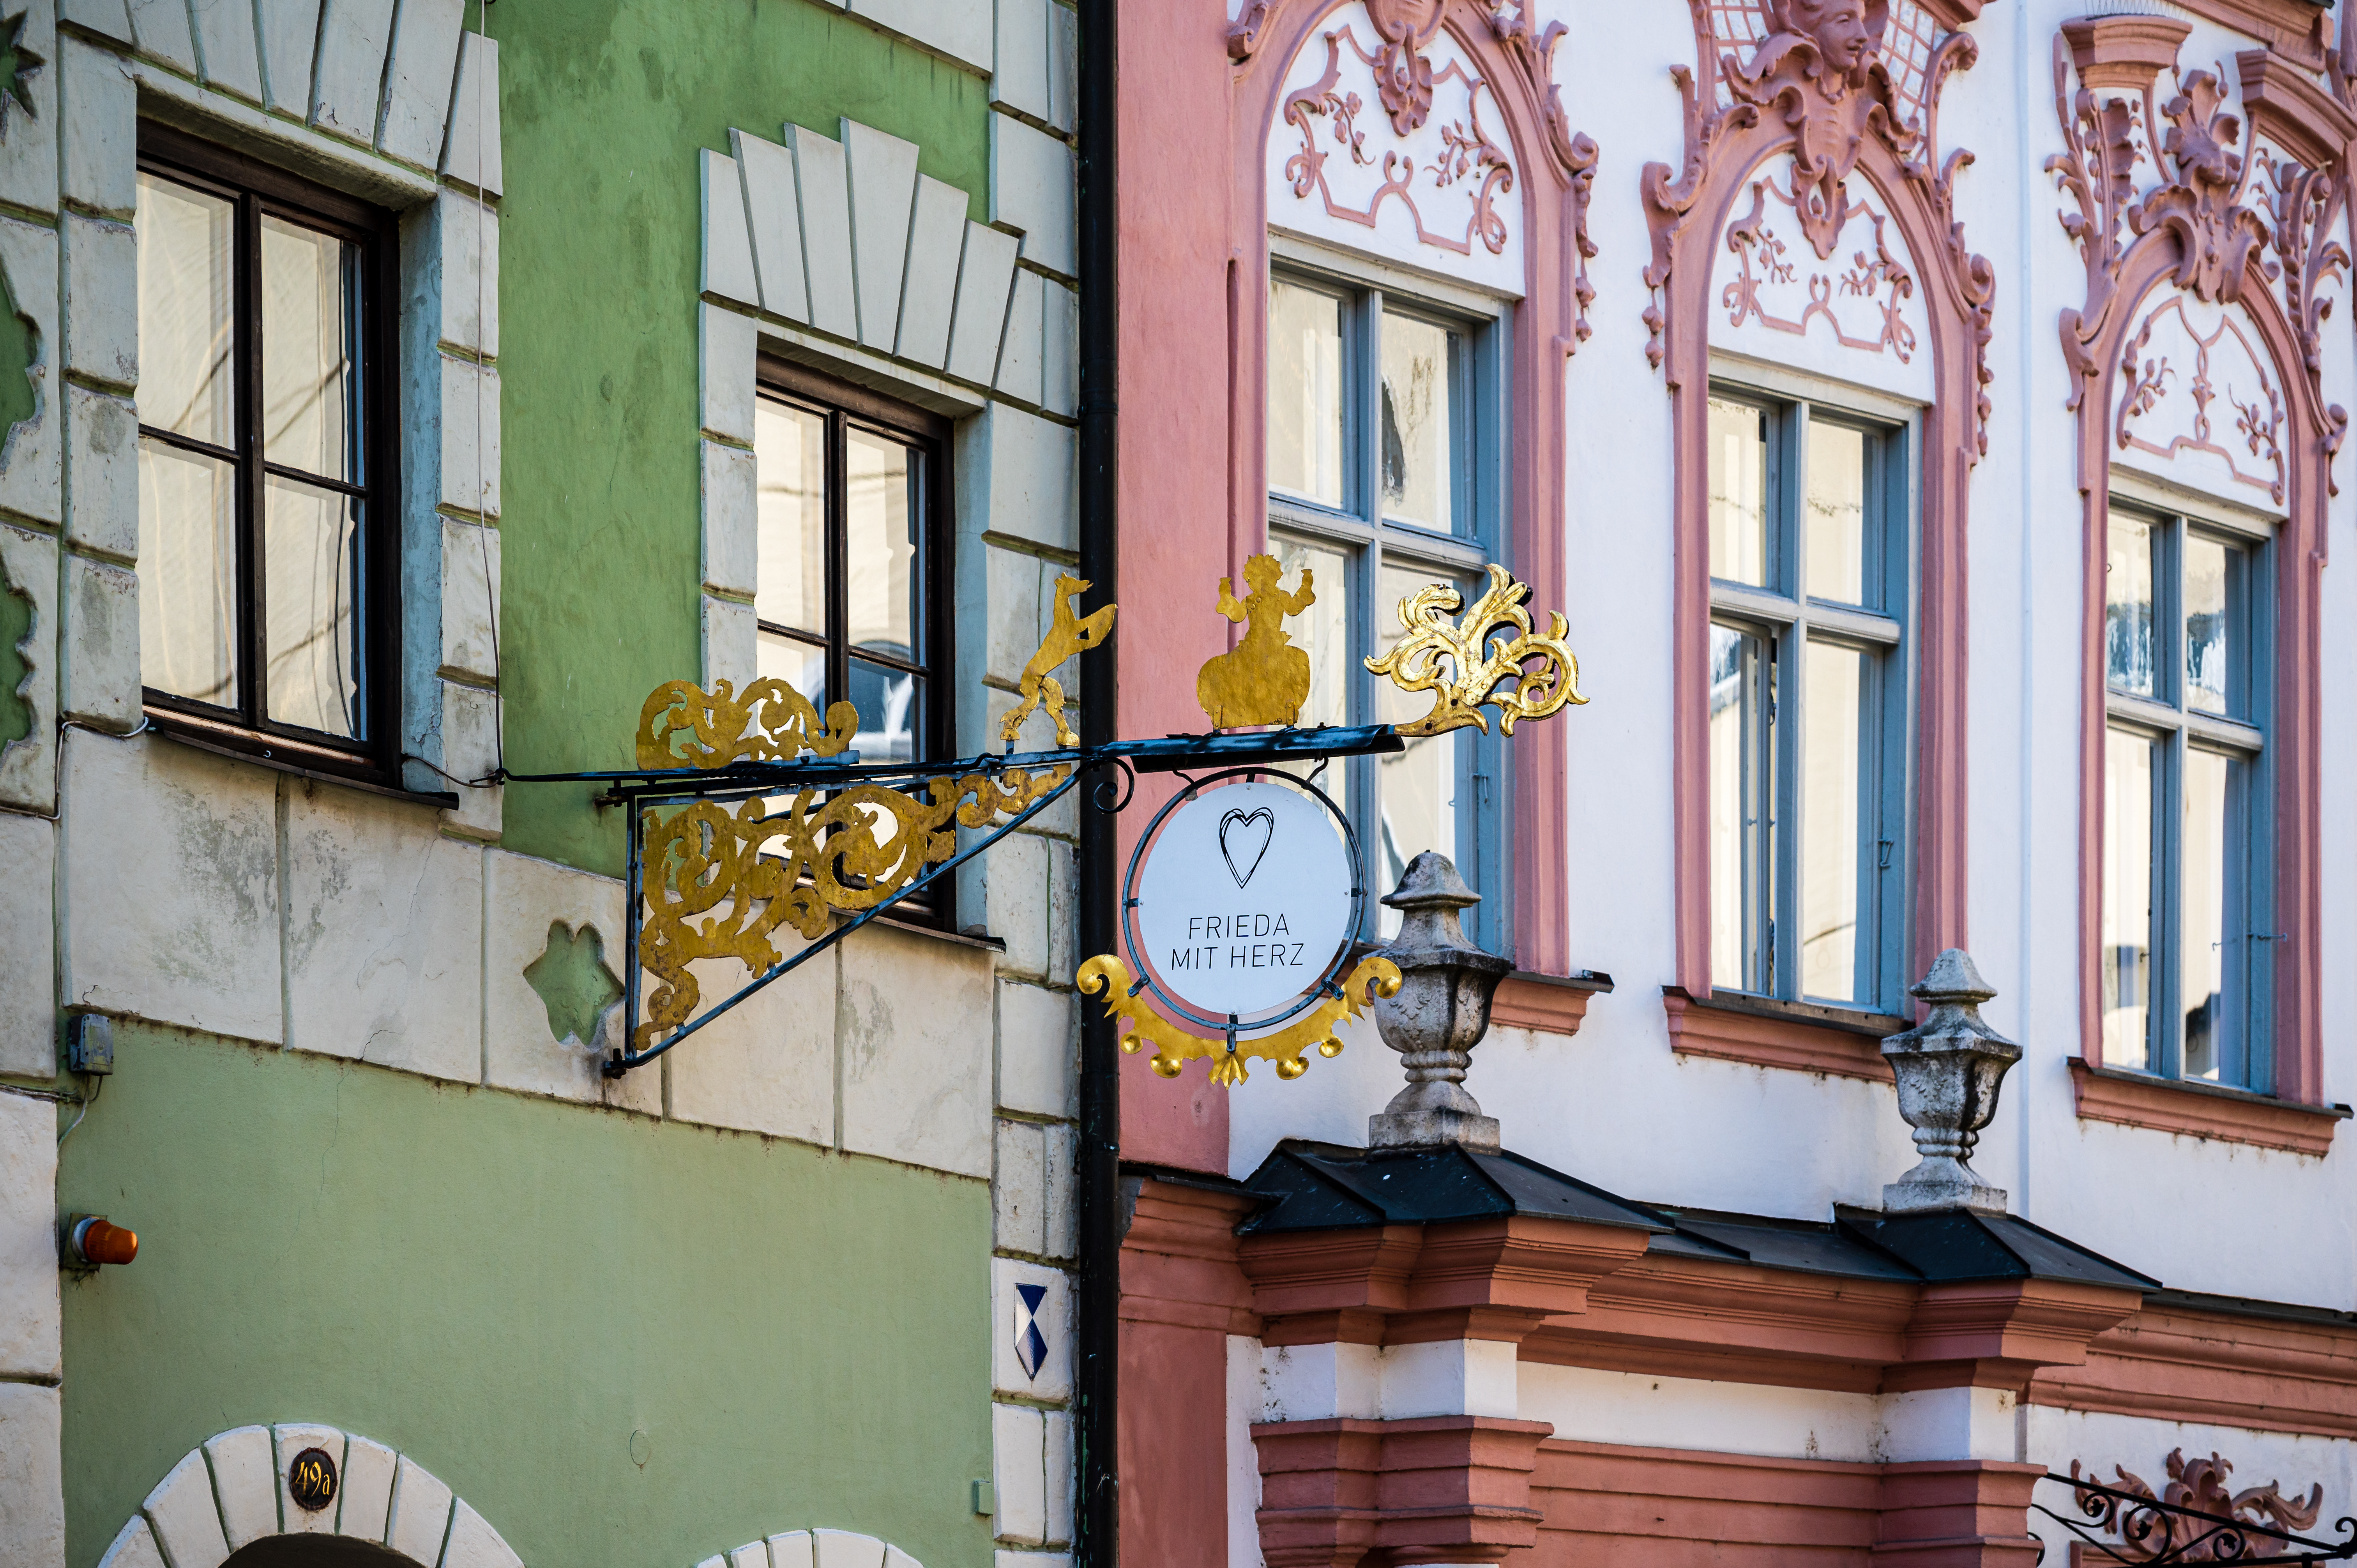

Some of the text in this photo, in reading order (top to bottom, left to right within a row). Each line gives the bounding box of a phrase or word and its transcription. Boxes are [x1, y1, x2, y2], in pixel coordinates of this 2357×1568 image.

[1189, 913, 1289, 939] FRIEDA
[1171, 943, 1304, 970] MIT HERZ
[295, 1462, 330, 1497] 49a
